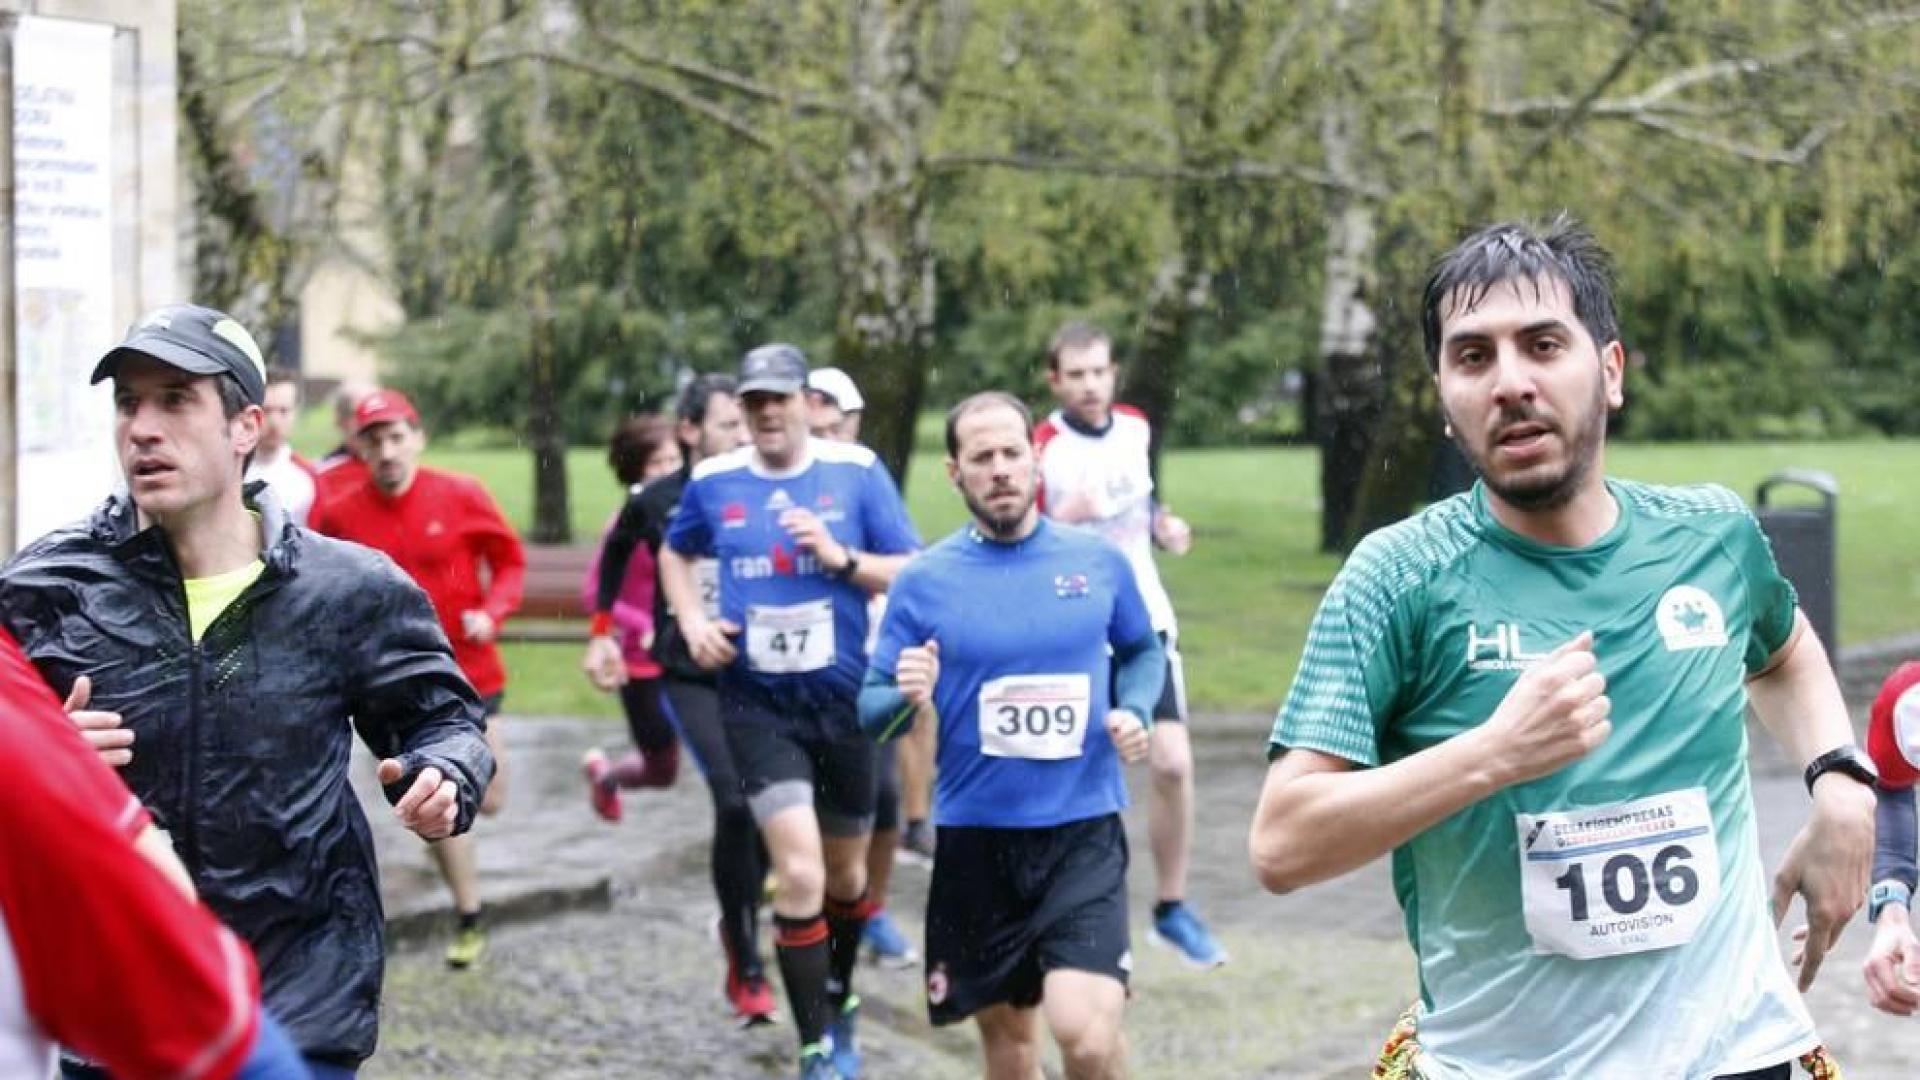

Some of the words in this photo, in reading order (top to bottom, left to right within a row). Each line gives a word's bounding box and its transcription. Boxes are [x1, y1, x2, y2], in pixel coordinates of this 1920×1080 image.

[770, 629, 809, 655] 47
[997, 704, 1075, 736] 309
[1556, 845, 1699, 922] 106
[1590, 914, 1674, 937] AUTOVISION
